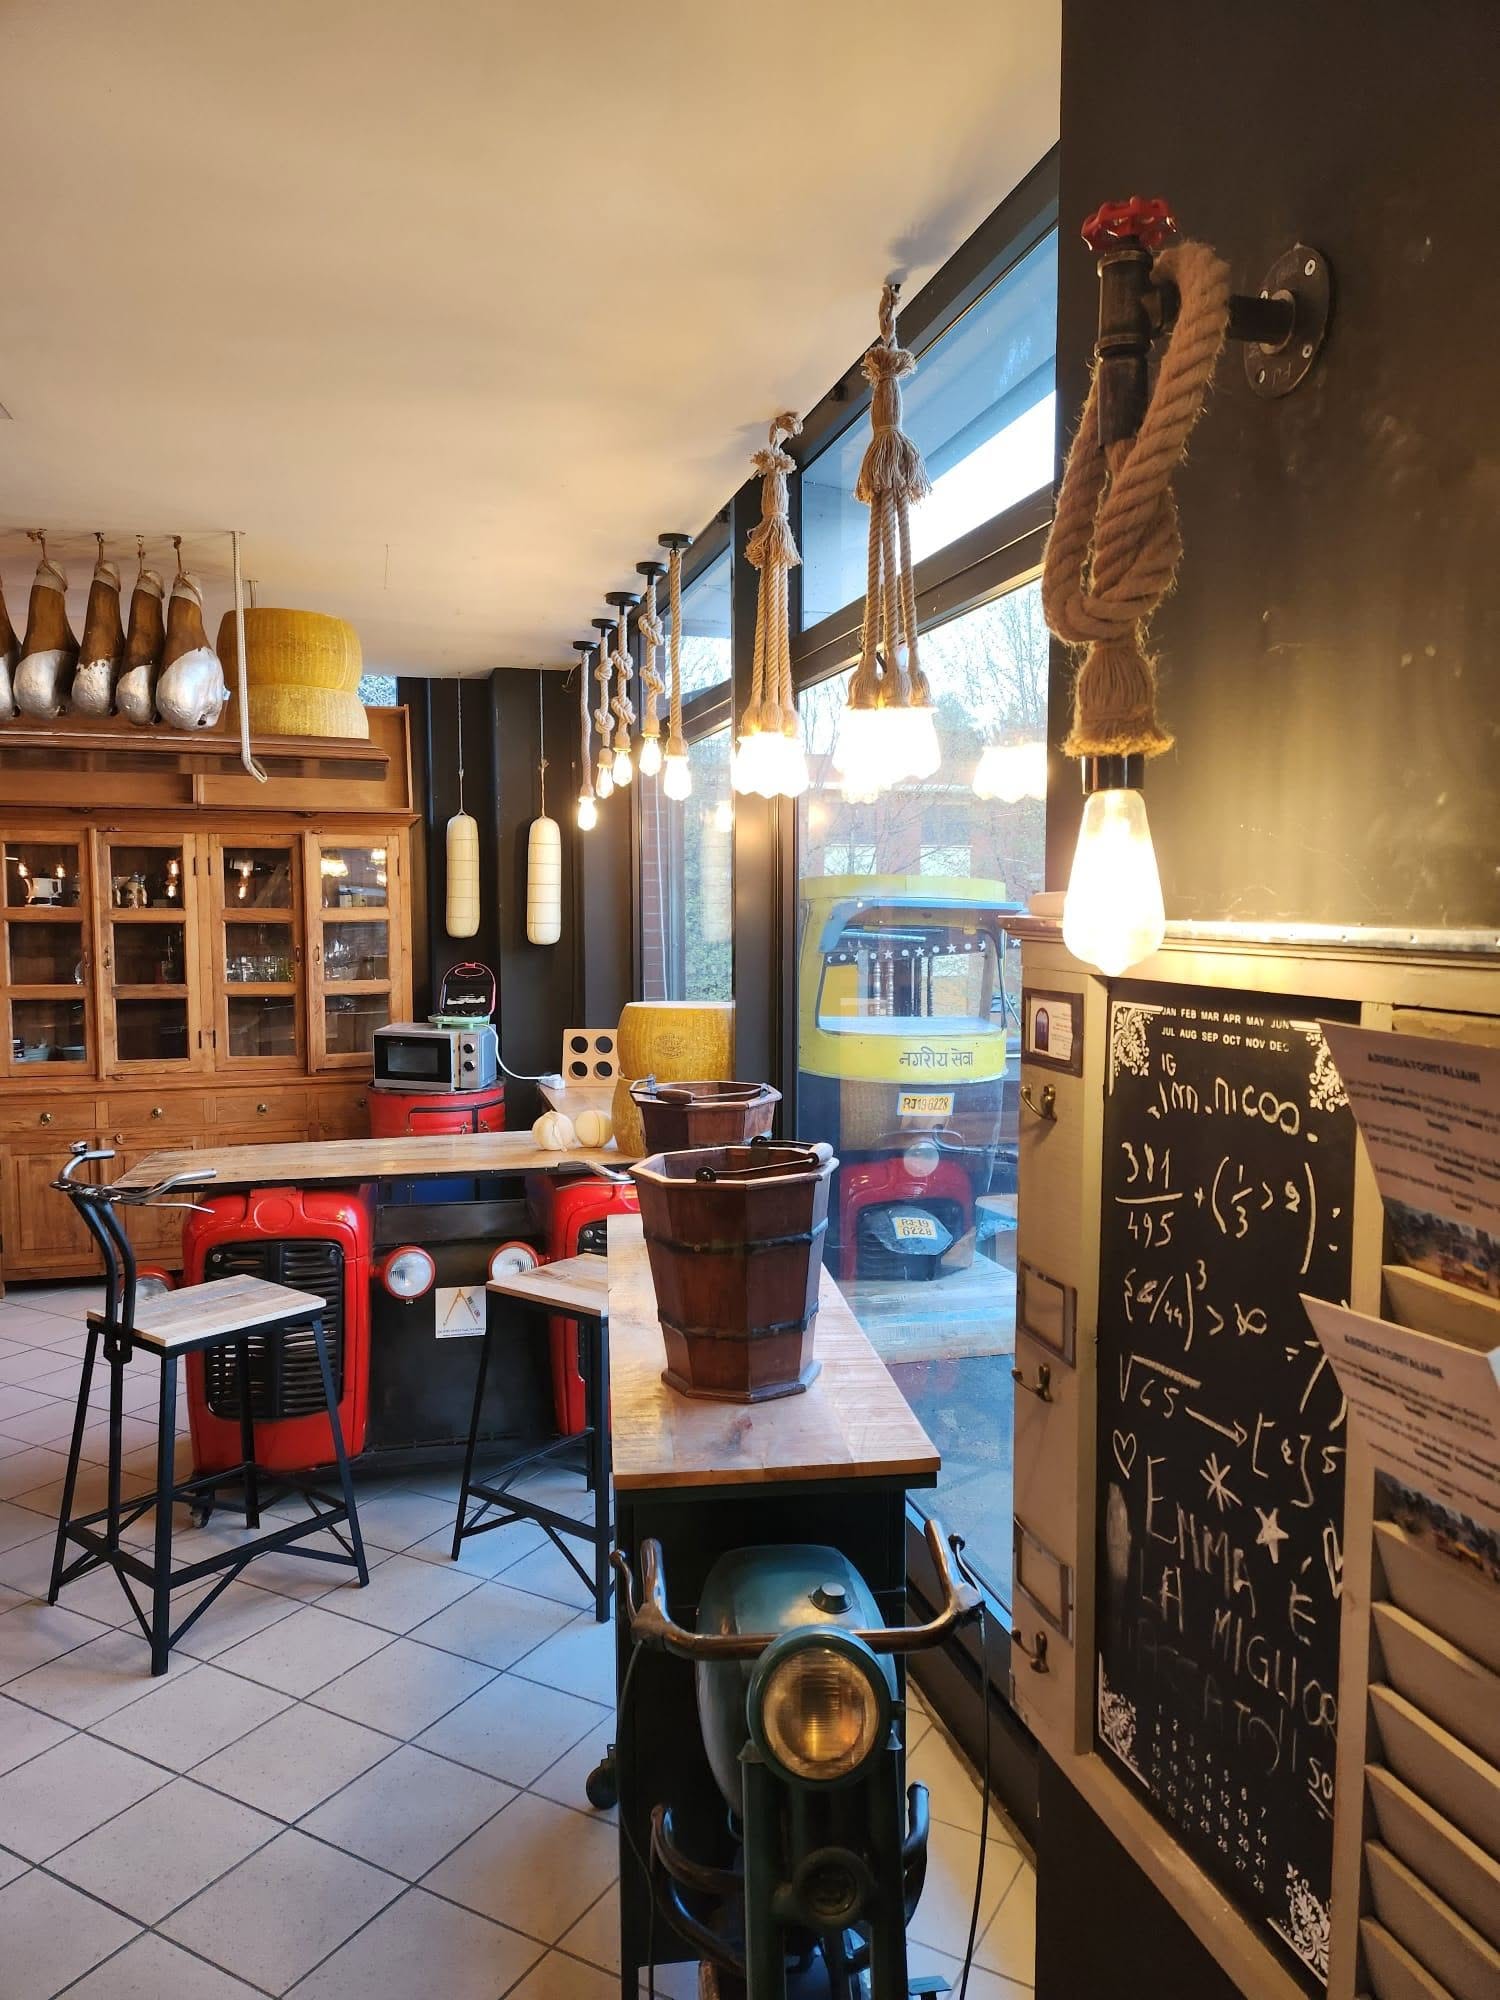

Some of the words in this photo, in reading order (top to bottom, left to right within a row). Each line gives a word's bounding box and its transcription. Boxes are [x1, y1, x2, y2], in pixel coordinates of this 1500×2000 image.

[1162, 1007, 1177, 1017] JAN
[1181, 1008, 1197, 1019] FEB
[1201, 1011, 1219, 1021] MAR
[1223, 1013, 1241, 1024] APR
[1246, 1016, 1265, 1027] MAY
[1270, 1020, 1290, 1030] JUN
[1161, 1027, 1175, 1037] JUL
[1180, 1029, 1197, 1040] AUG
[1201, 1031, 1219, 1042] SEP
[1222, 1034, 1241, 1046] OCT
[1245, 1037, 1266, 1049] NOV
[951, 1047, 973, 1067] सेवा
